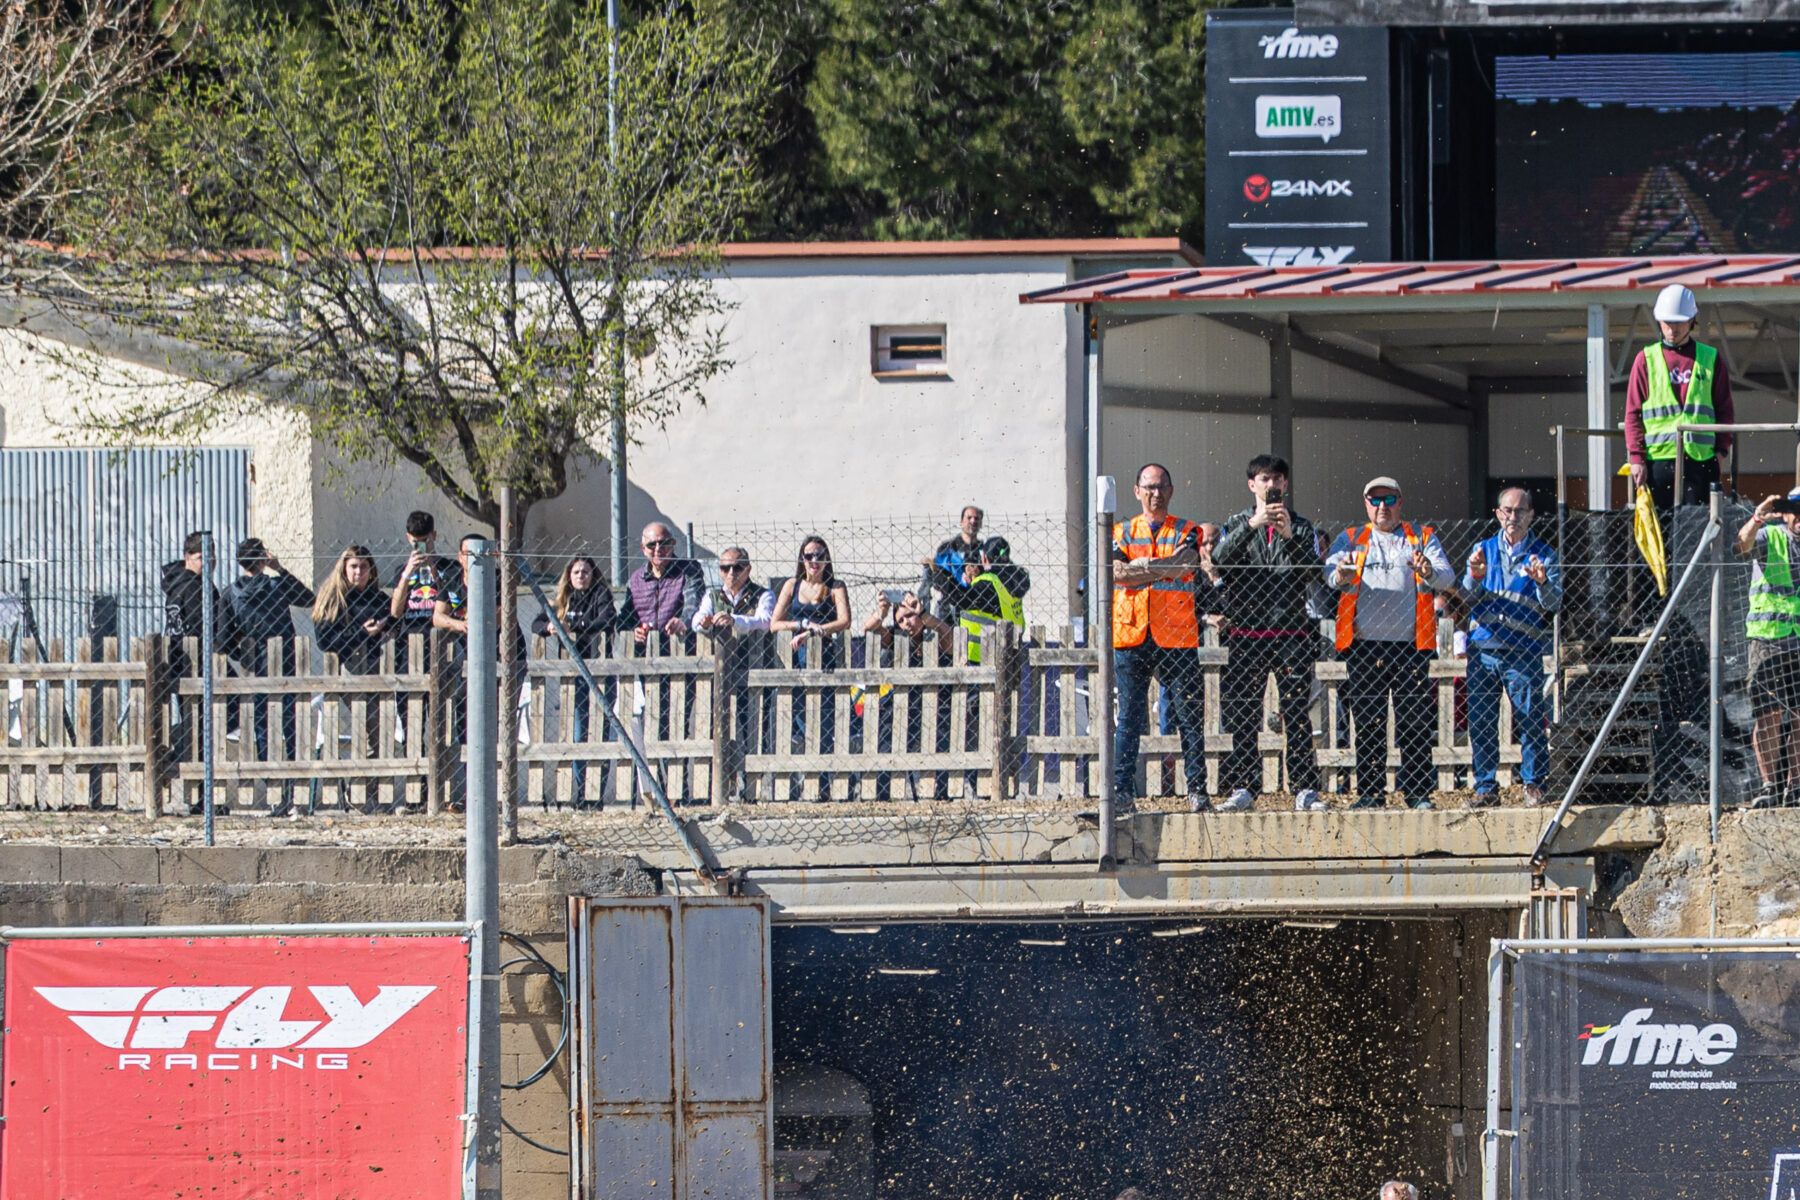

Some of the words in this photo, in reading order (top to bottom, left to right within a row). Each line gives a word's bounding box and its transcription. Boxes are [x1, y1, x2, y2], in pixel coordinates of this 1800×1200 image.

[1258, 28, 1339, 59] rfme
[1271, 179, 1353, 198] 24MX
[33, 986, 439, 1049] FLY
[1581, 1007, 1738, 1066] rfme
[118, 1053, 350, 1071] RACING
[1652, 1068, 1669, 1079] real
[1670, 1068, 1714, 1079] federación
[1649, 1080, 1699, 1091] motociclista
[1700, 1080, 1738, 1092] española
